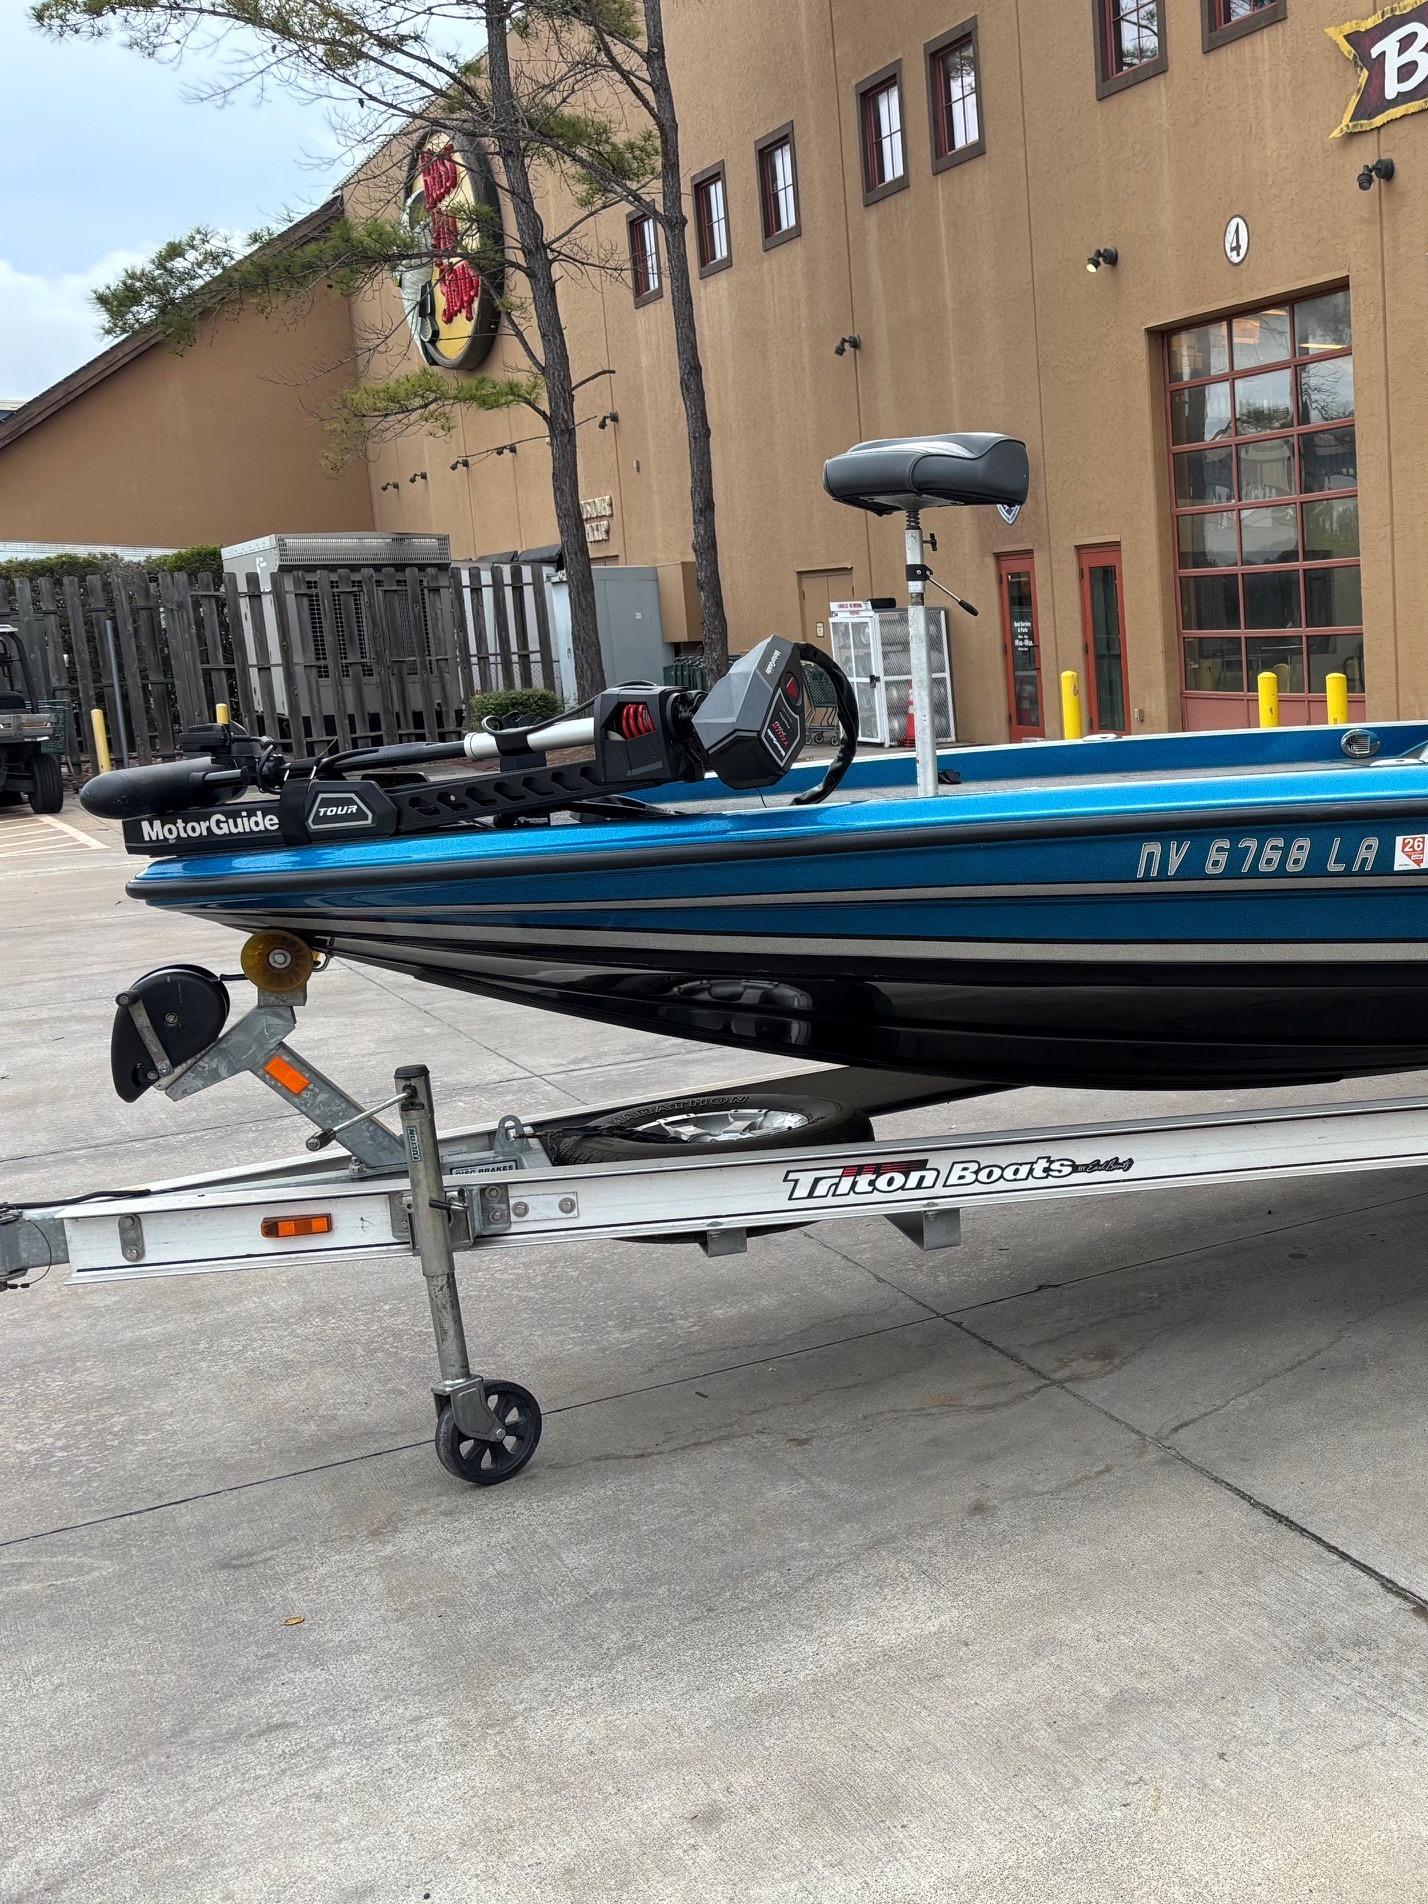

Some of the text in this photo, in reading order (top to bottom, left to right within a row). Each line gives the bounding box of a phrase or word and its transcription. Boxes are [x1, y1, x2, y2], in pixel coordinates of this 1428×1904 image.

[1230, 222, 1242, 257] 4
[141, 811, 279, 841] MotorGuide
[318, 805, 358, 817] TOUR
[1136, 837, 1379, 878] NV 6768 LA
[1404, 837, 1424, 852] 26
[408, 1126, 420, 1161] FULTON
[479, 1164, 514, 1174] BRAKES
[784, 1159, 941, 1200] Triton
[943, 1156, 1076, 1188] Boats
